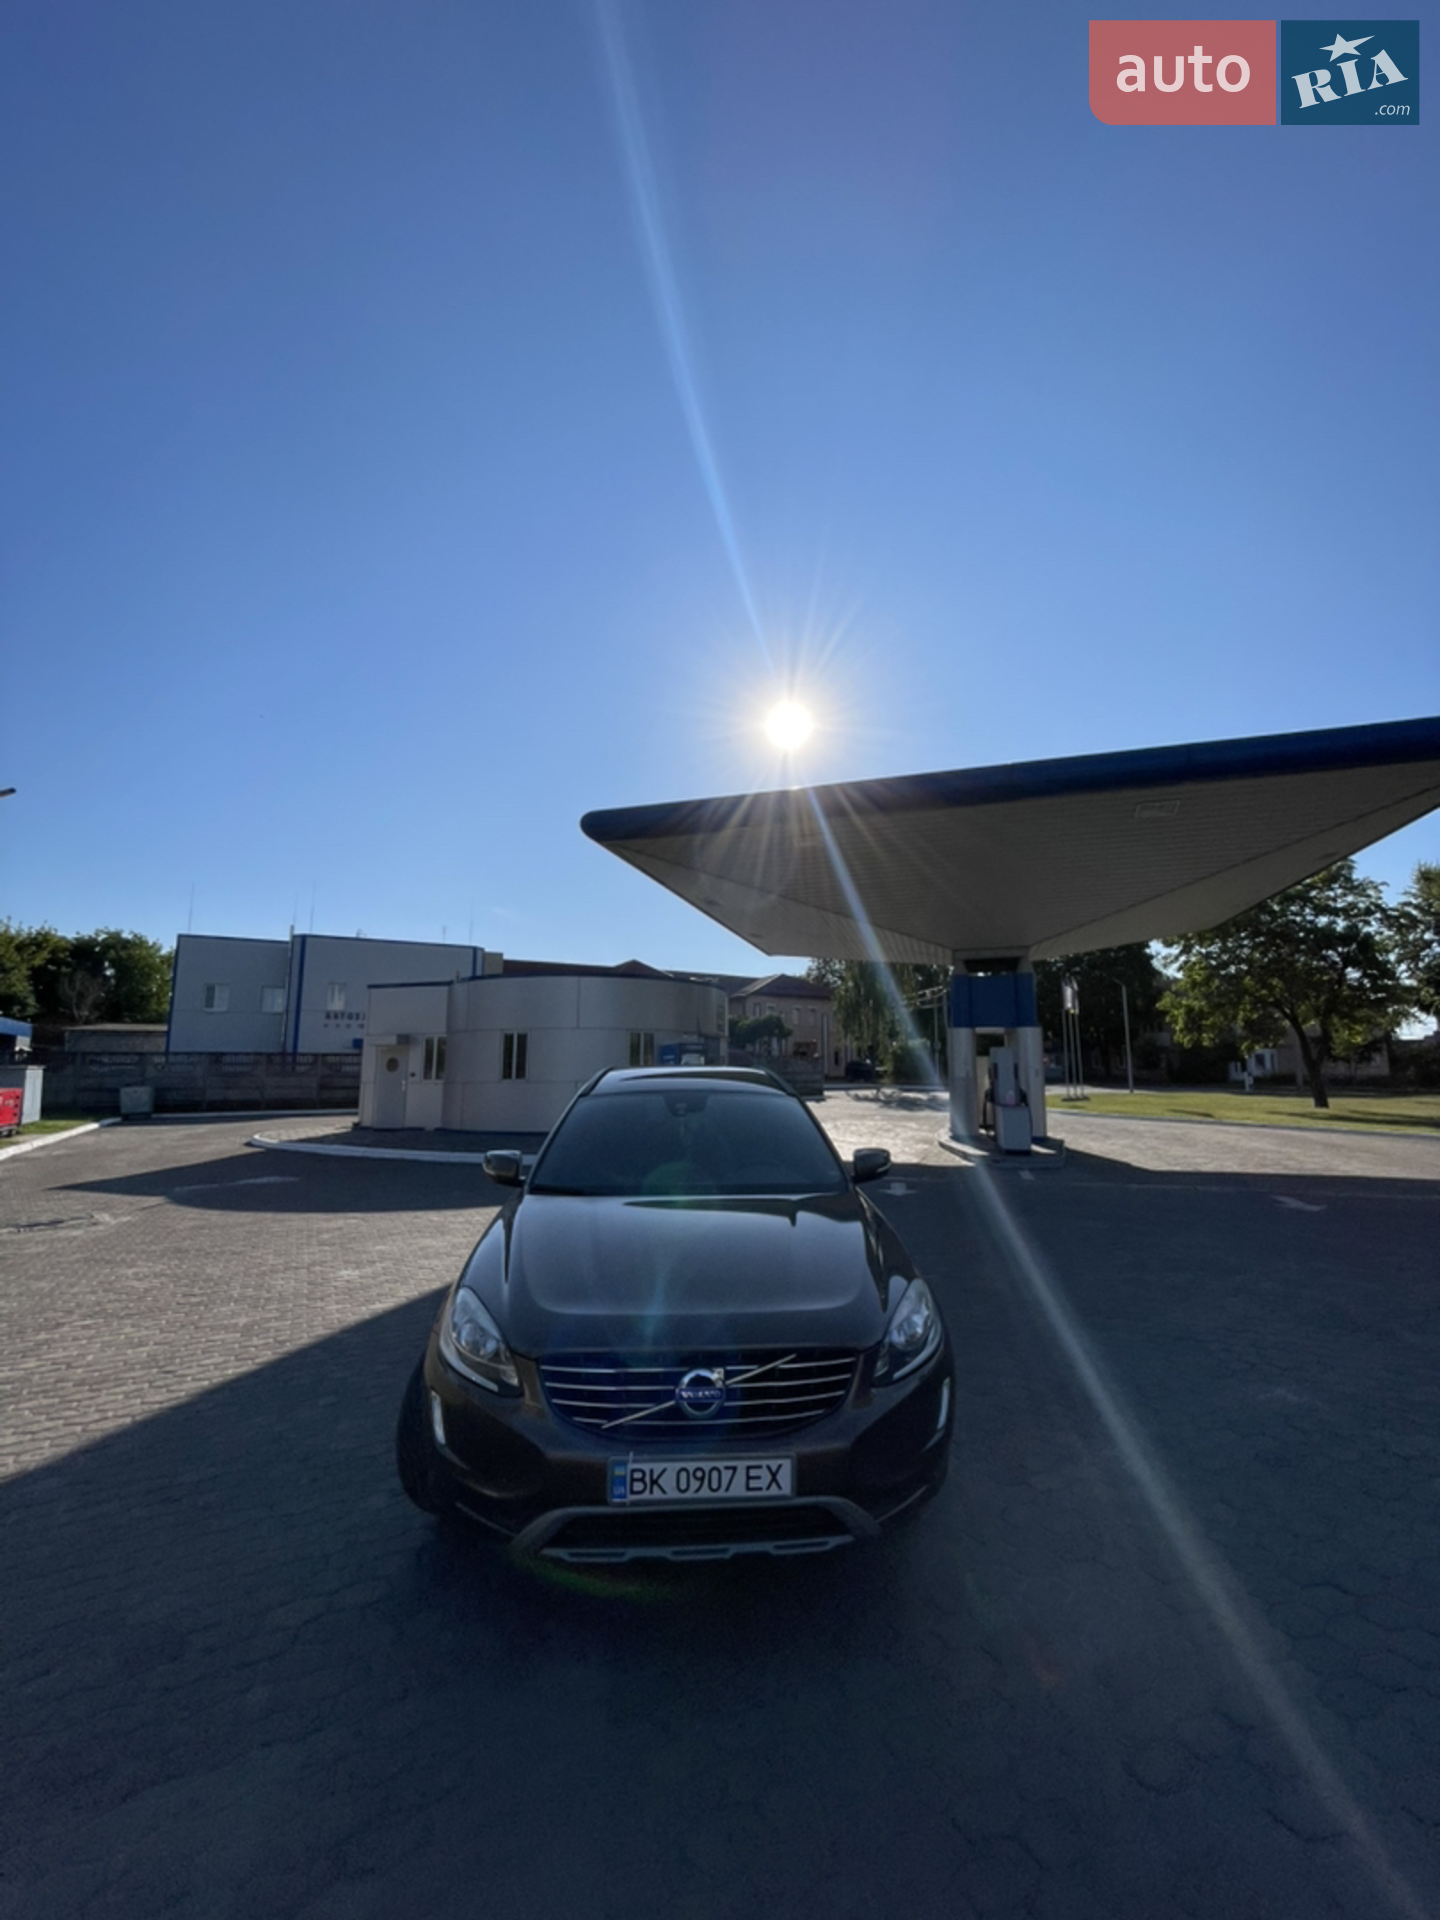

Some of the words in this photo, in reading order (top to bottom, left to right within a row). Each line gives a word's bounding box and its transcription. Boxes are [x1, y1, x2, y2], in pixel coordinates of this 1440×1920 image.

[628, 1467, 668, 1495] BK
[675, 1465, 738, 1494] 0907
[745, 1463, 783, 1492] EX
